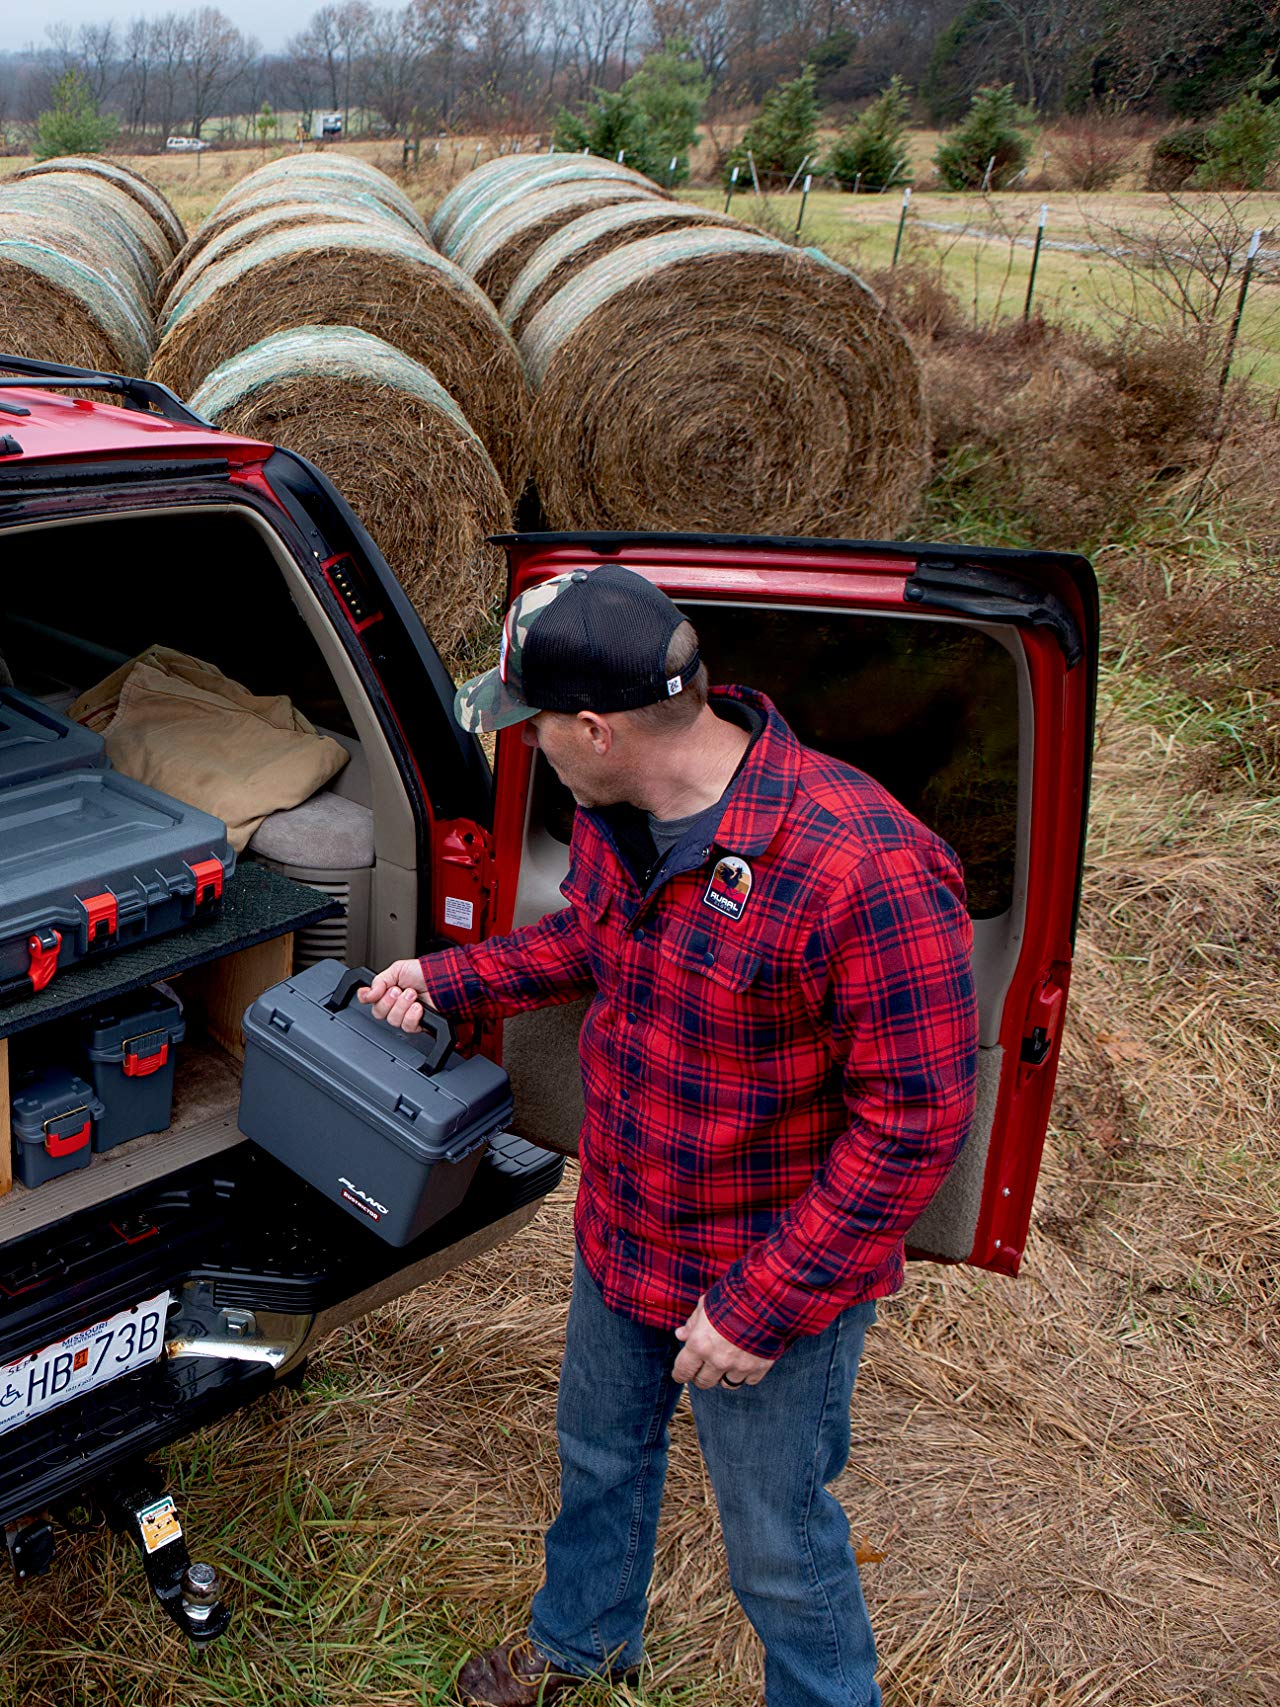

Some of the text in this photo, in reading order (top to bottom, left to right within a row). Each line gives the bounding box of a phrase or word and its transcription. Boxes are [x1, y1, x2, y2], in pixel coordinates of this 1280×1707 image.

[710, 891, 739, 911] RURAL
[338, 1177, 389, 1214] PLANO
[343, 1191, 379, 1220] RUSTRICTOR
[61, 1322, 108, 1348] MISSOURI
[7, 1359, 31, 1377] SEP
[26, 1311, 160, 1407] HB 73B
[75, 1352, 86, 1365] 21
